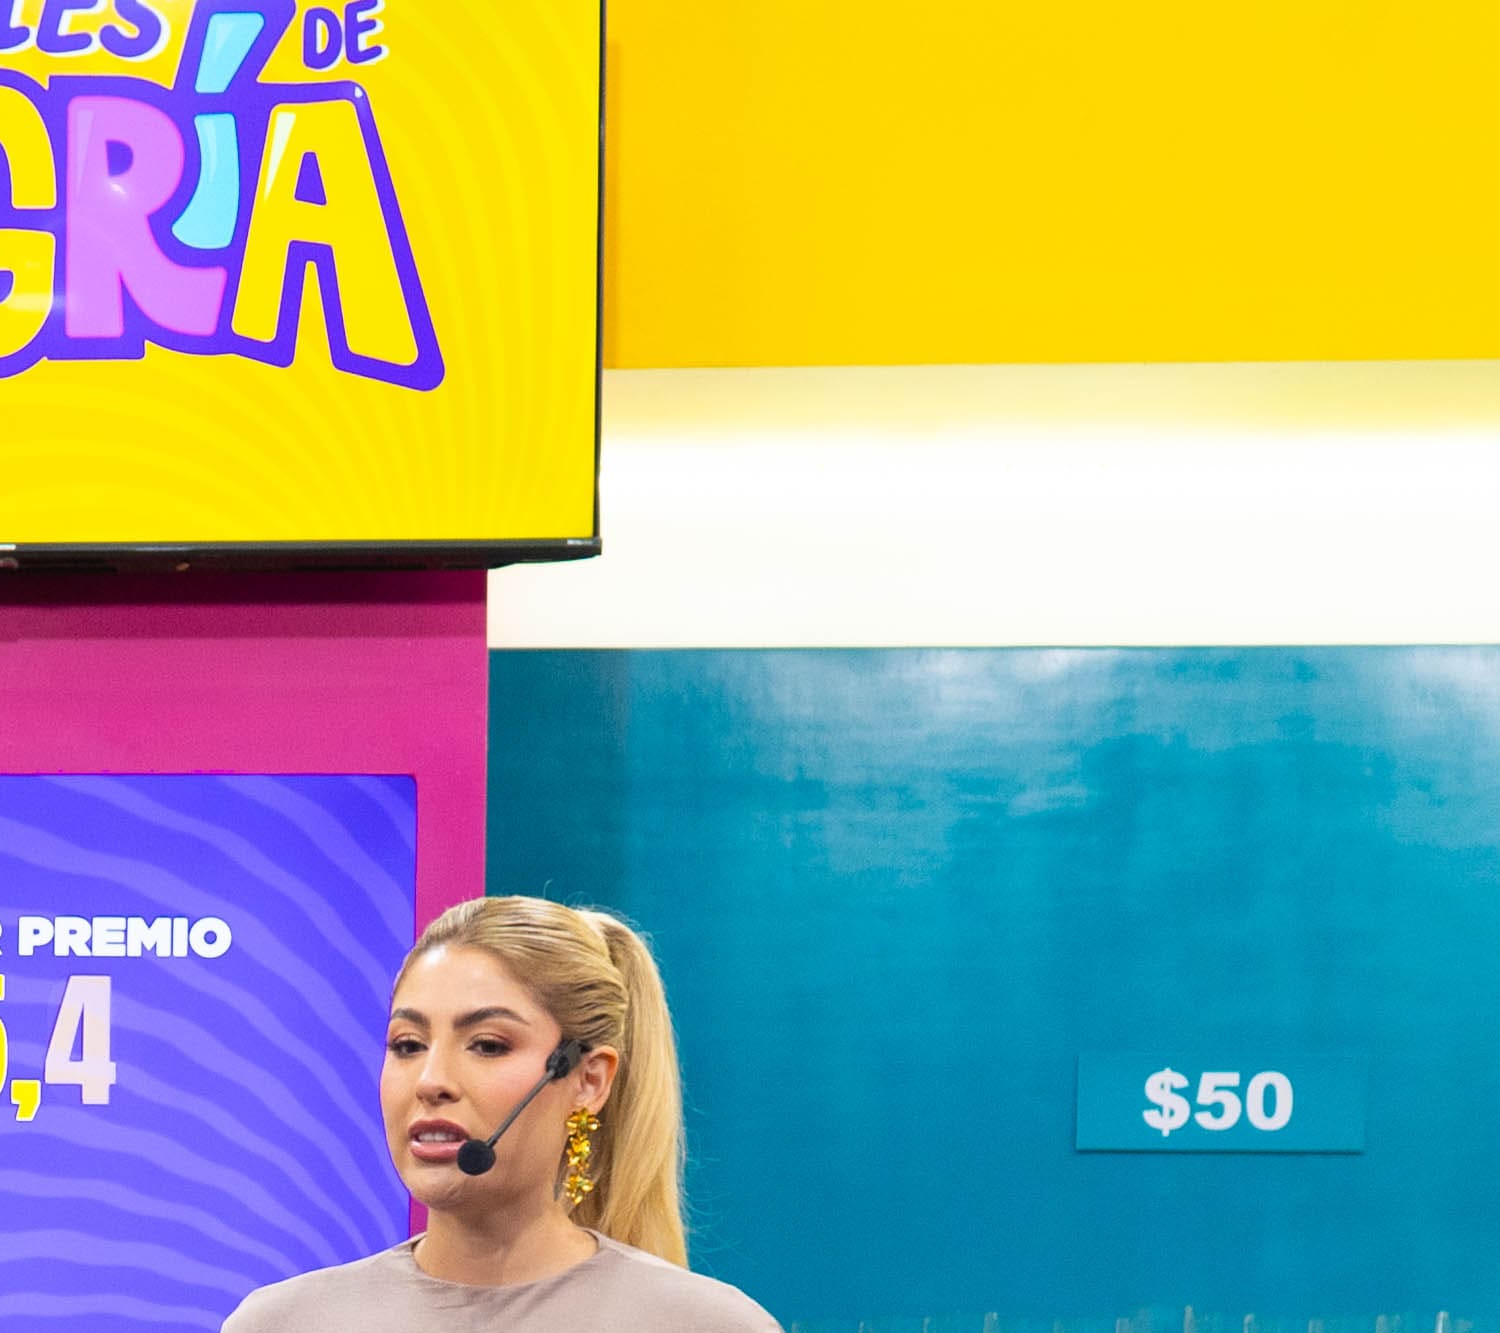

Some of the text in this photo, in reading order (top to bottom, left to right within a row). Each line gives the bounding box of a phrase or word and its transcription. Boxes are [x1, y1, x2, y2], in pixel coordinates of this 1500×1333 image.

[300, 0, 386, 70] DE
[18, 916, 233, 959] PREMIO
[1142, 1067, 1294, 1137] $50
